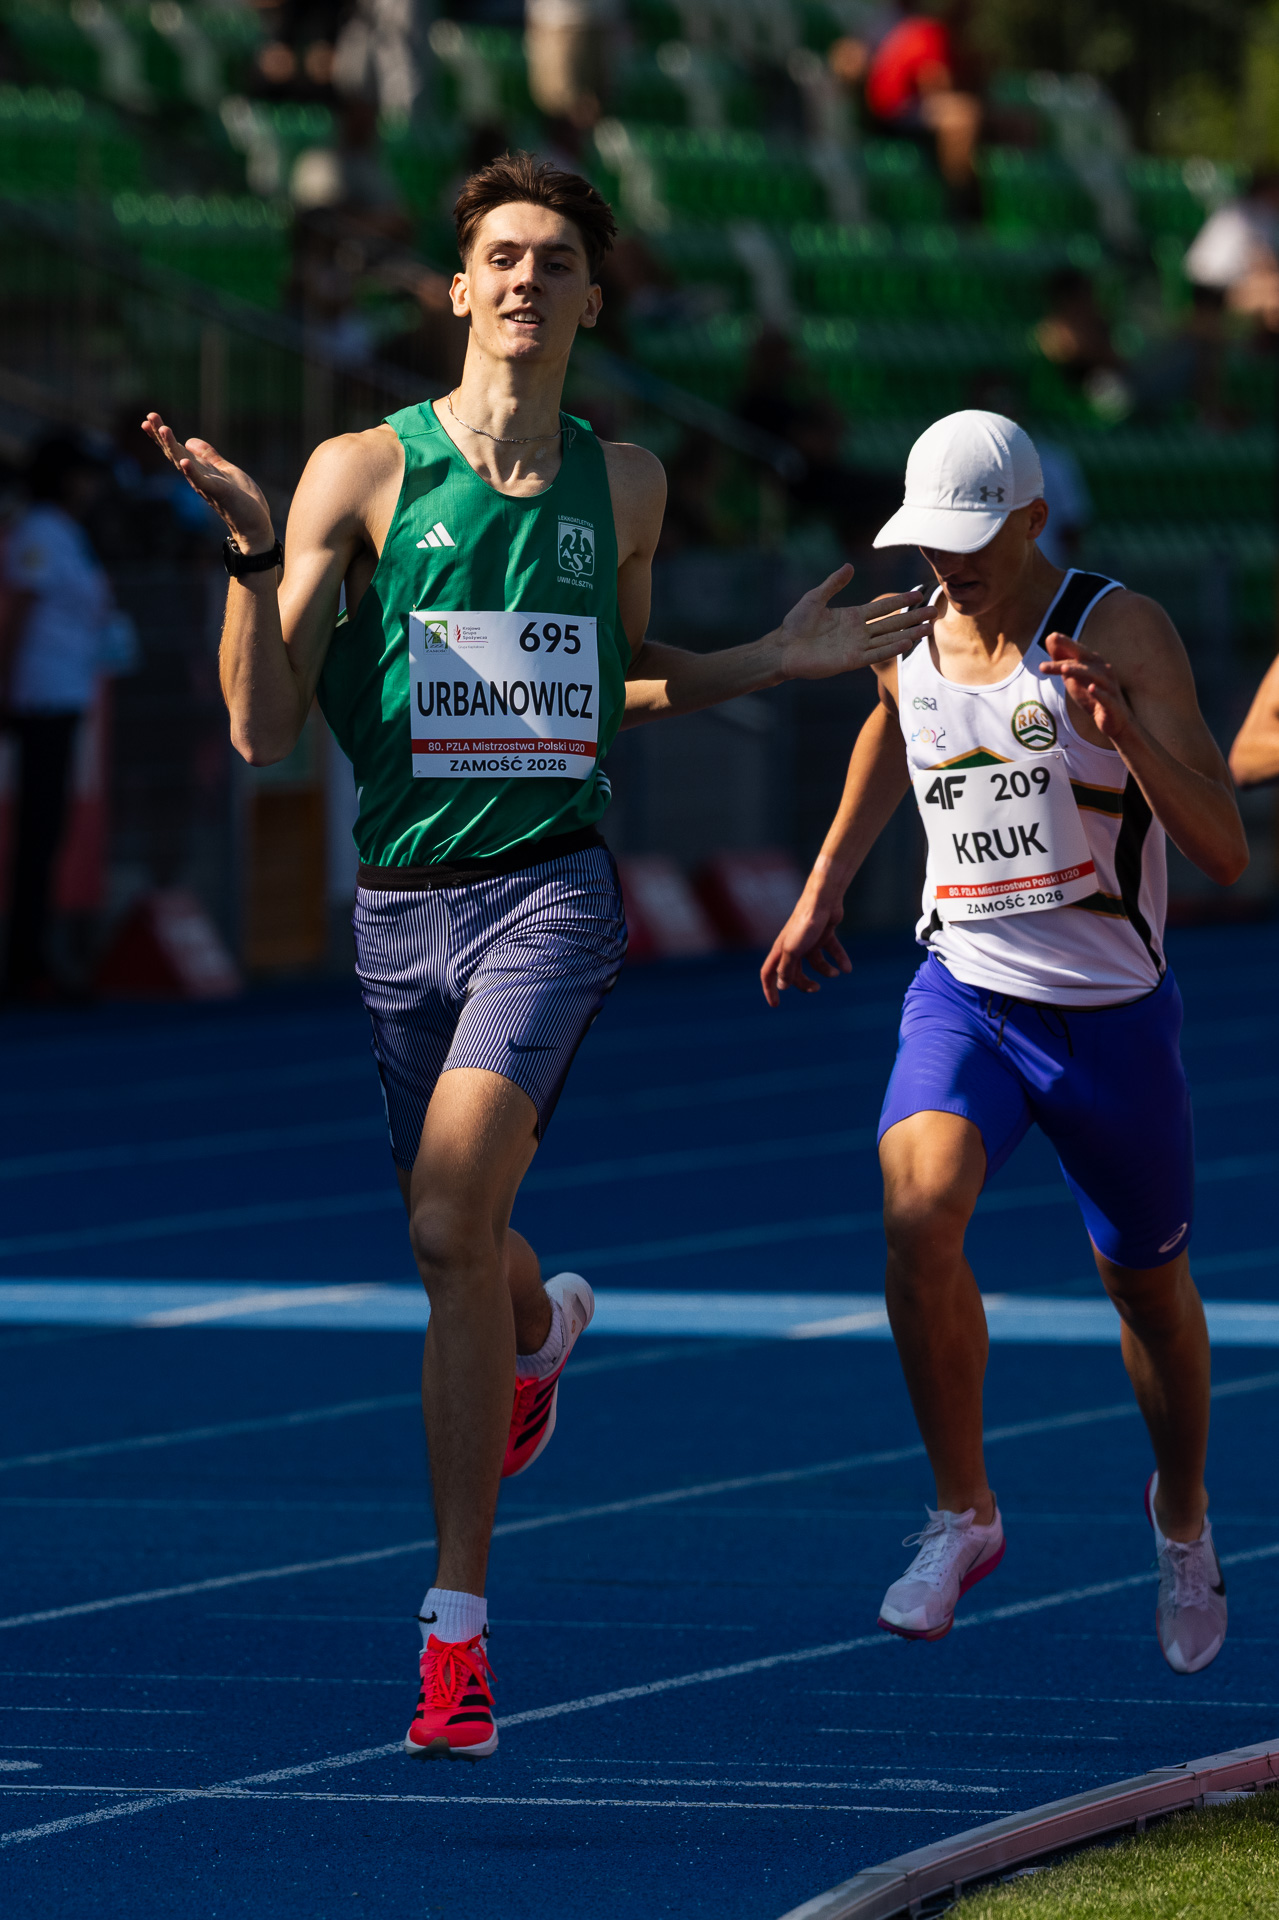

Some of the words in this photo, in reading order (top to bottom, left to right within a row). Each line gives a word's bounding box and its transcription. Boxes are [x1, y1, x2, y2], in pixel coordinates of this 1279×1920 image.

[557, 515, 594, 528] LEKKOATLETYKA
[519, 622, 581, 654] 695
[417, 680, 593, 720] URBANOWICZ
[1018, 708, 1049, 729] RKS
[428, 742, 444, 752] 80.
[446, 742, 470, 752] PZLA
[472, 741, 535, 751] Mistrzostwa
[537, 741, 567, 752] Polski
[568, 743, 585, 753] U20
[450, 755, 523, 772] ZAMOŚĆ
[526, 758, 567, 772] 2026
[924, 775, 967, 810] 4F
[990, 766, 1051, 802] 209
[952, 822, 1048, 865] KRUK
[948, 886, 961, 897] 80.
[961, 886, 978, 897] PZLA
[978, 881, 1031, 896] Mistrzostwa
[1031, 873, 1060, 888] Polski
[1060, 868, 1080, 881] U20
[966, 894, 1026, 915] ZAMOŚĆ
[1027, 889, 1064, 906] 2026
